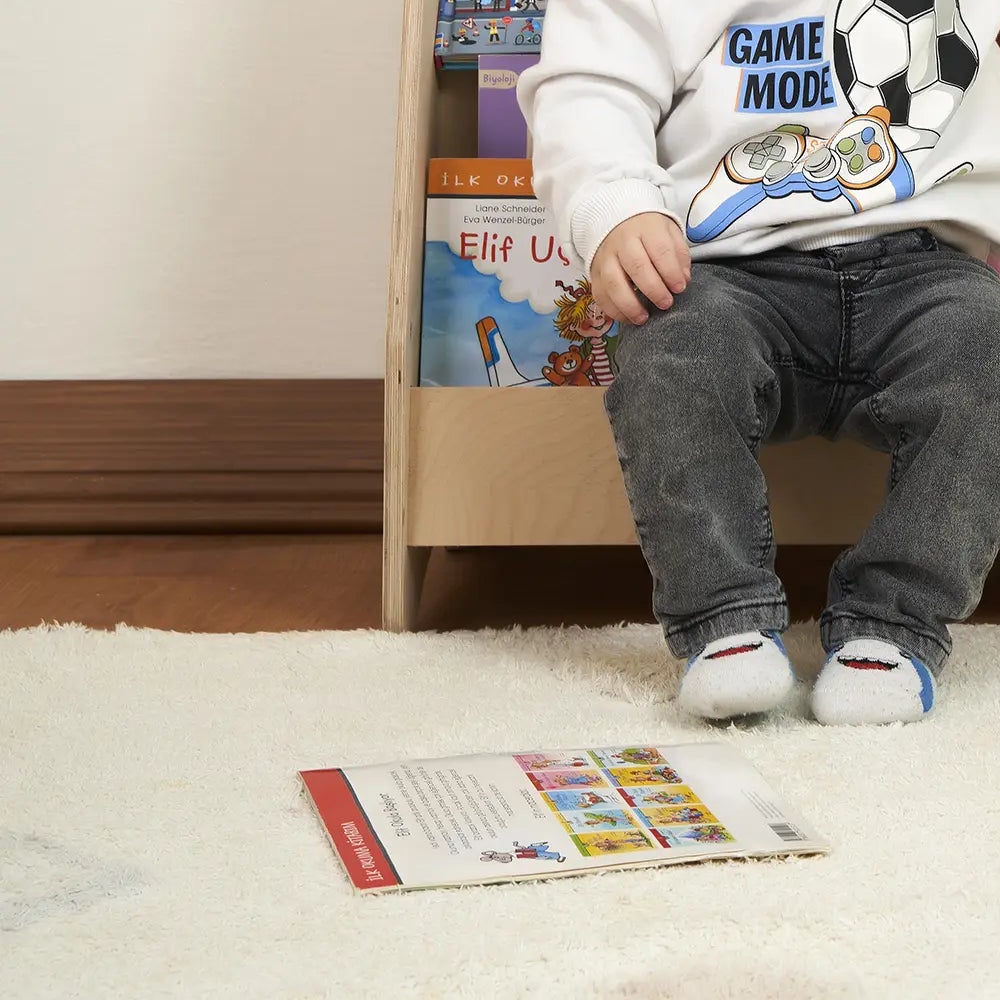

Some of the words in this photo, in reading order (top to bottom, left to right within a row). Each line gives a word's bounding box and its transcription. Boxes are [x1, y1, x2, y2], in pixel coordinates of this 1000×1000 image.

[728, 20, 824, 64] GAME
[483, 73, 515, 86] Biyoloji
[742, 66, 834, 110] MODE
[442, 172, 481, 186] İLK
[475, 204, 499, 213] Liane
[502, 204, 546, 213] Schneider
[463, 216, 480, 224] Eva
[482, 215, 545, 226] Wenzel-Bürger
[460, 231, 513, 263] Elif
